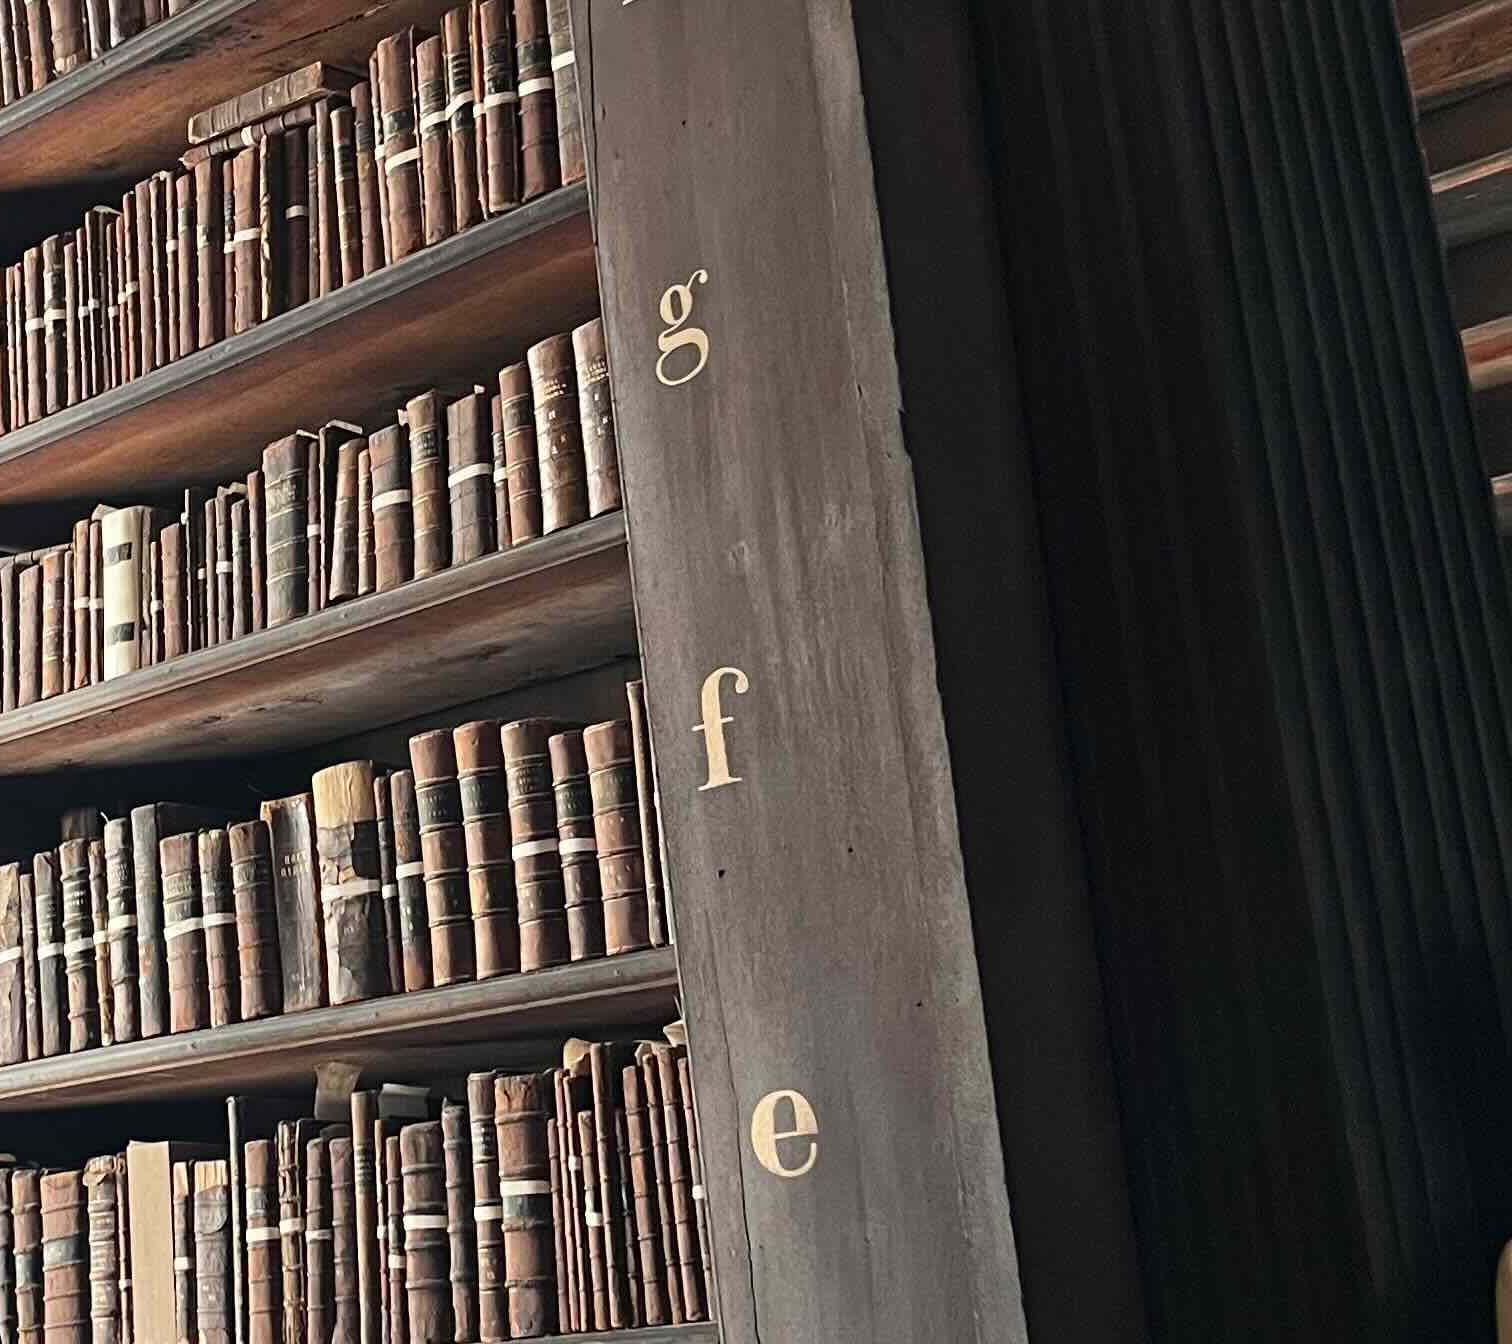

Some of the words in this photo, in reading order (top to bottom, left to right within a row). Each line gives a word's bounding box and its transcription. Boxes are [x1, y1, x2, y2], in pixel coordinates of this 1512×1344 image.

[655, 268, 710, 386] g
[691, 666, 749, 792] f
[751, 1088, 819, 1178] e
